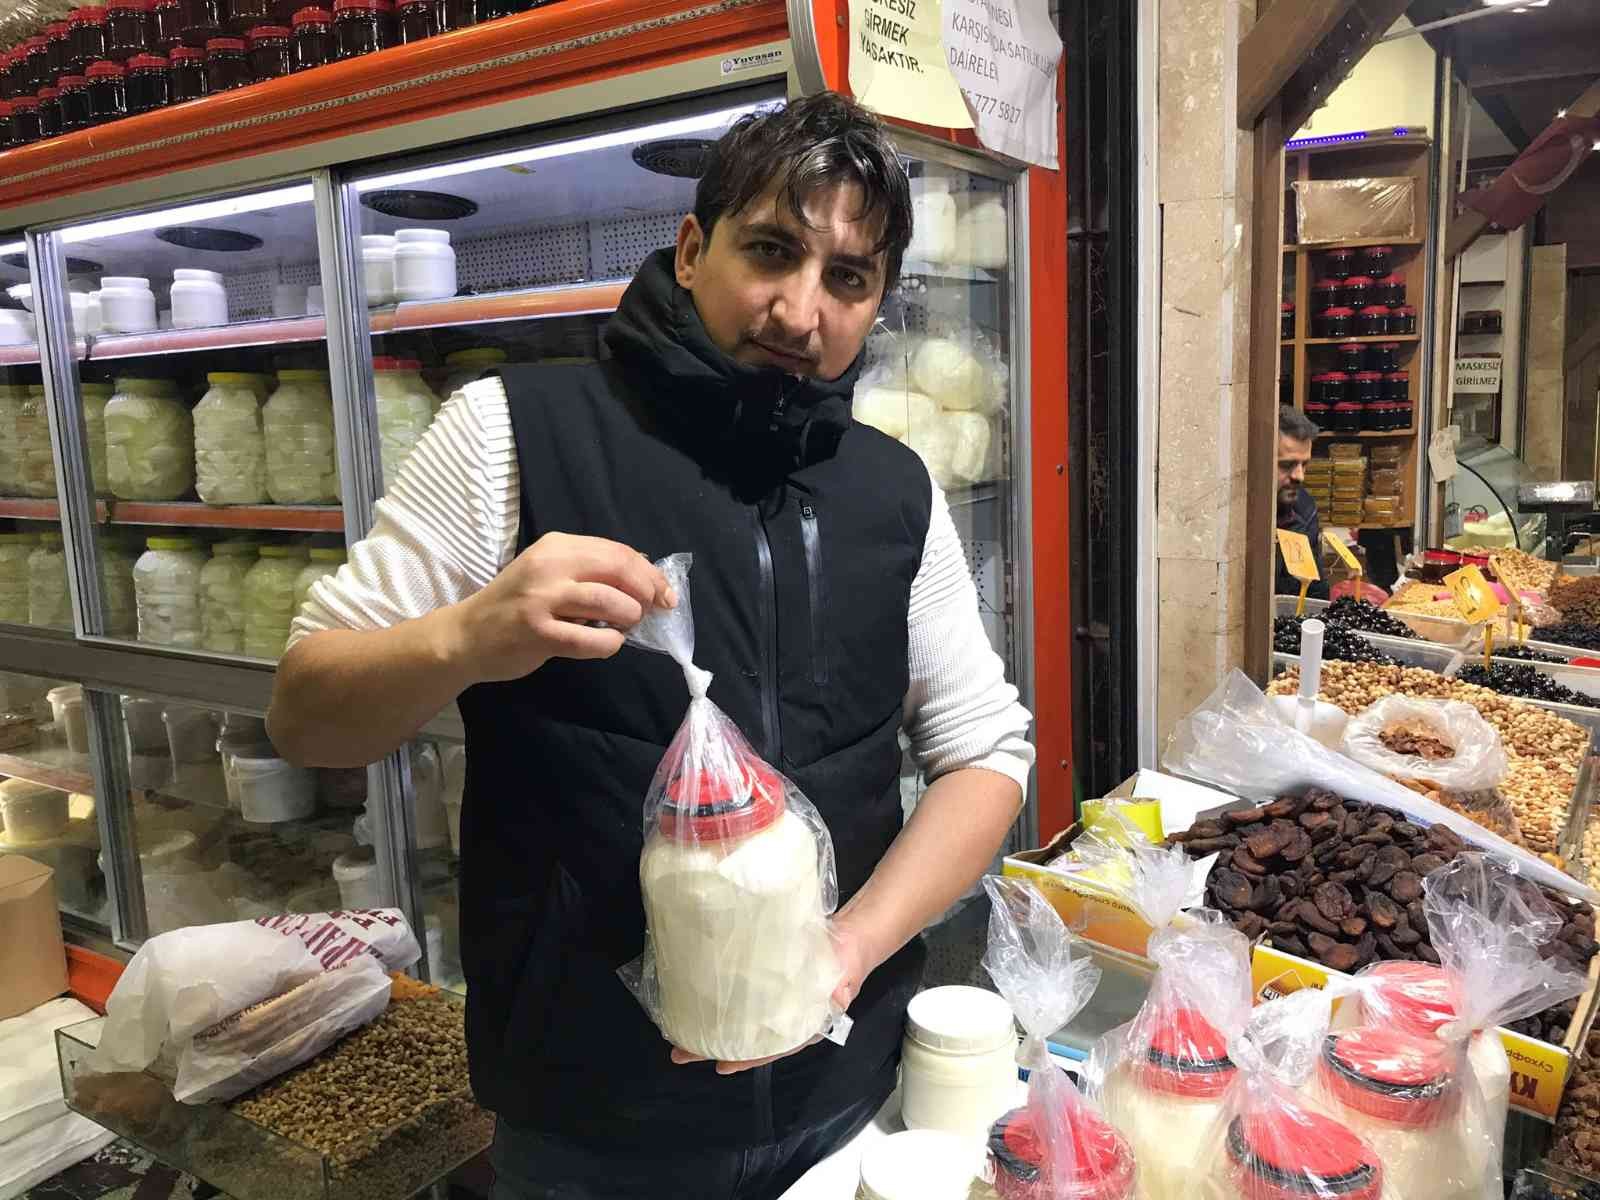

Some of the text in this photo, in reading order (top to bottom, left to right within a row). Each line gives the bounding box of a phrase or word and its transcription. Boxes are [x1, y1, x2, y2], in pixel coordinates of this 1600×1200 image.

[864, 8, 909, 46] GİRMEK
[860, 32, 924, 74] YASAKTIR.
[975, 94, 1021, 124] 777 5827
[1456, 375, 1497, 386] GİRİLMEZ
